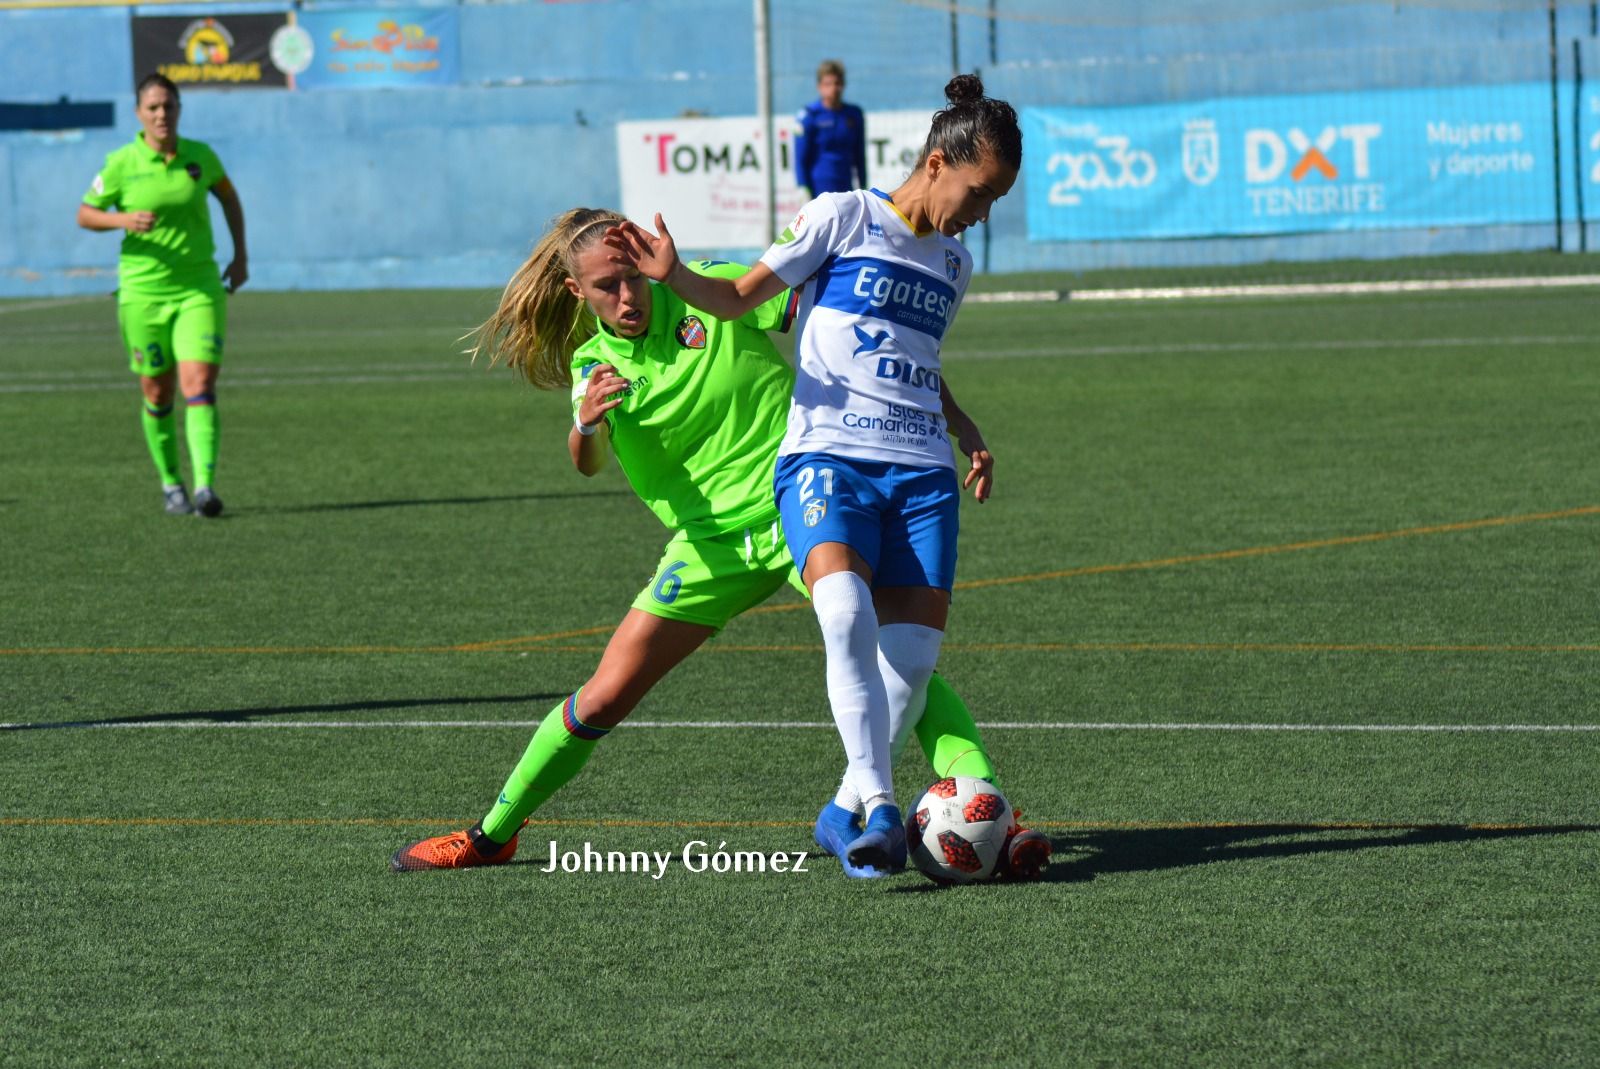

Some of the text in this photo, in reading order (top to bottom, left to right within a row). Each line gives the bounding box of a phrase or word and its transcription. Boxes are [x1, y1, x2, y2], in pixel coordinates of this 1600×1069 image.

[1426, 121, 1523, 150] Mujeres
[1245, 124, 1382, 183] DXT
[1428, 149, 1534, 182] y deporte
[1247, 182, 1386, 217] TENERIFE
[147, 342, 165, 368] 3
[842, 412, 927, 437] Canarias
[797, 466, 834, 507] 21
[651, 559, 689, 605] 6
